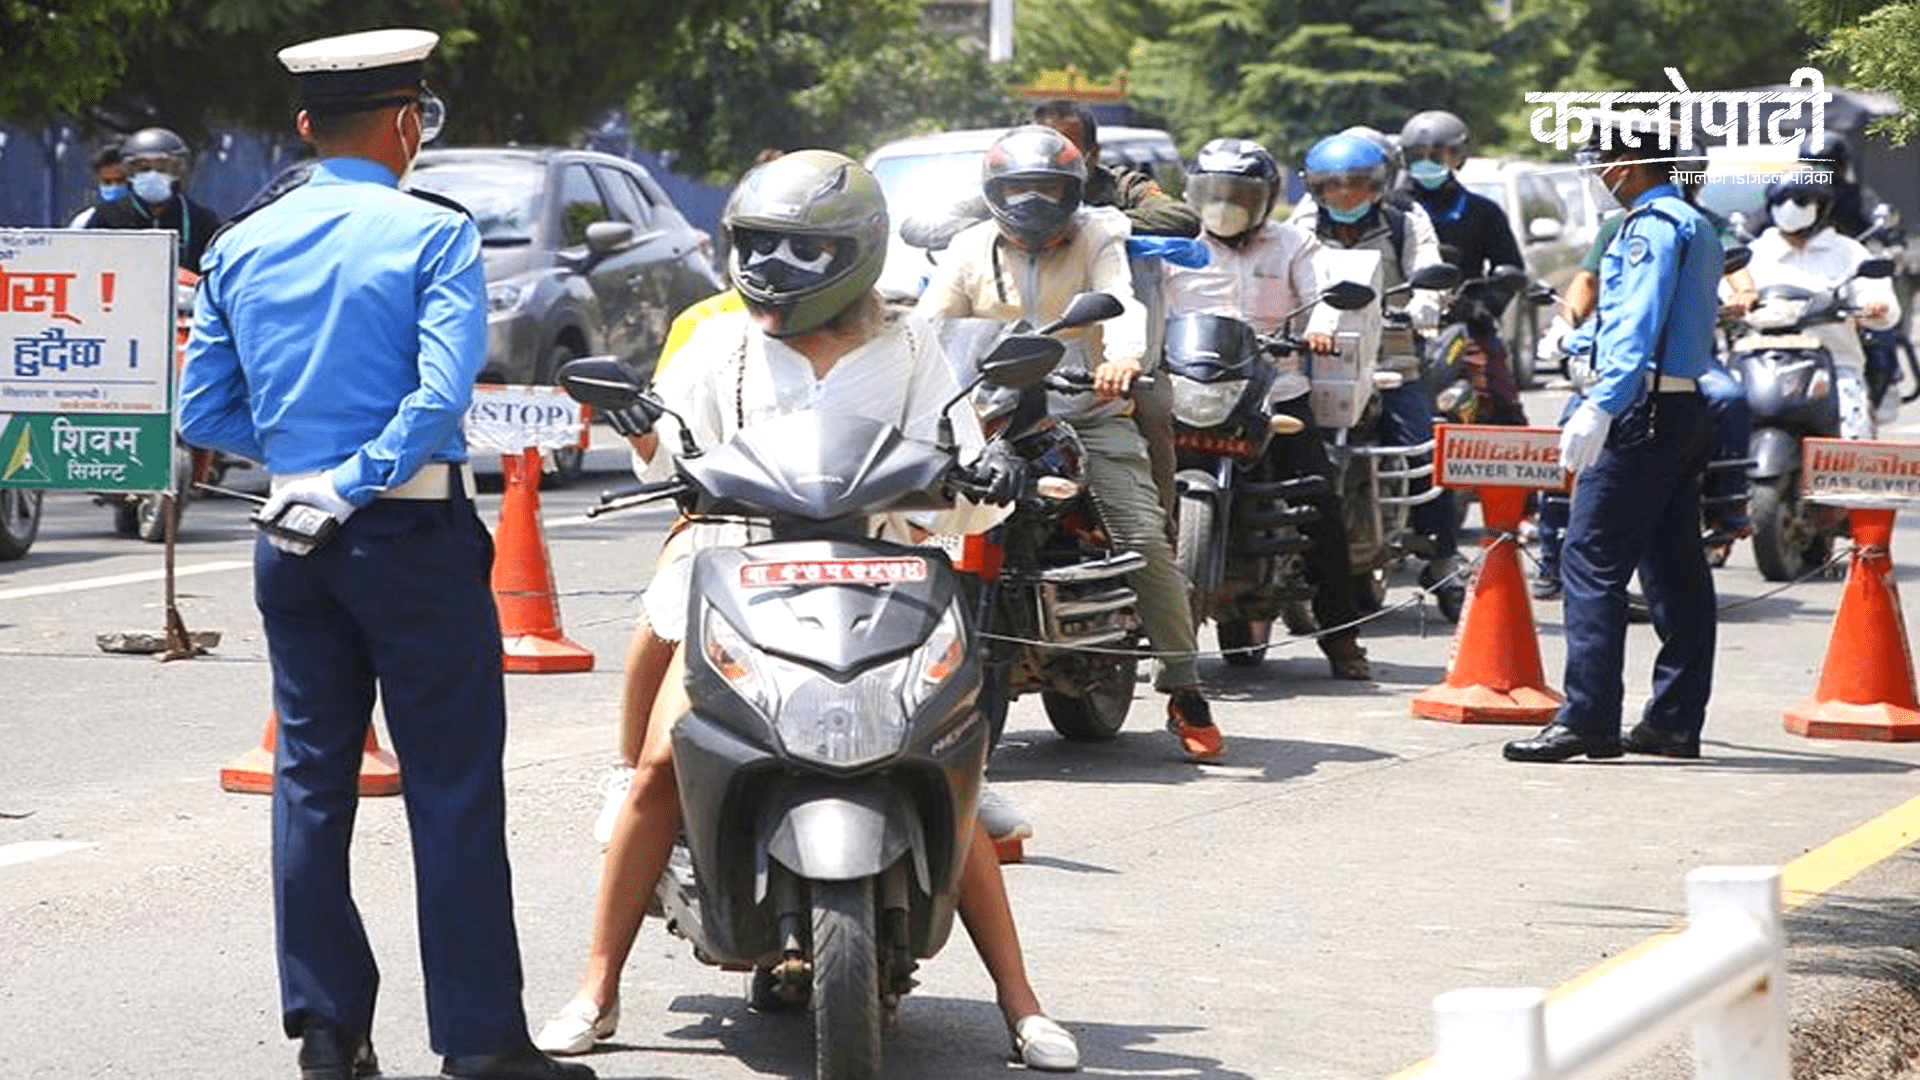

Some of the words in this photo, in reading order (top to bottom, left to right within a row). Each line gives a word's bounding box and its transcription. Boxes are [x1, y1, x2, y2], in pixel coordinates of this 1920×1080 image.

[51, 417, 143, 466] शिवम्
[67, 458, 127, 481] सिमेन्ट
[1447, 463, 1508, 478] WATER
[1515, 464, 1562, 480] TANK
[1857, 476, 1920, 492] GEYSE
